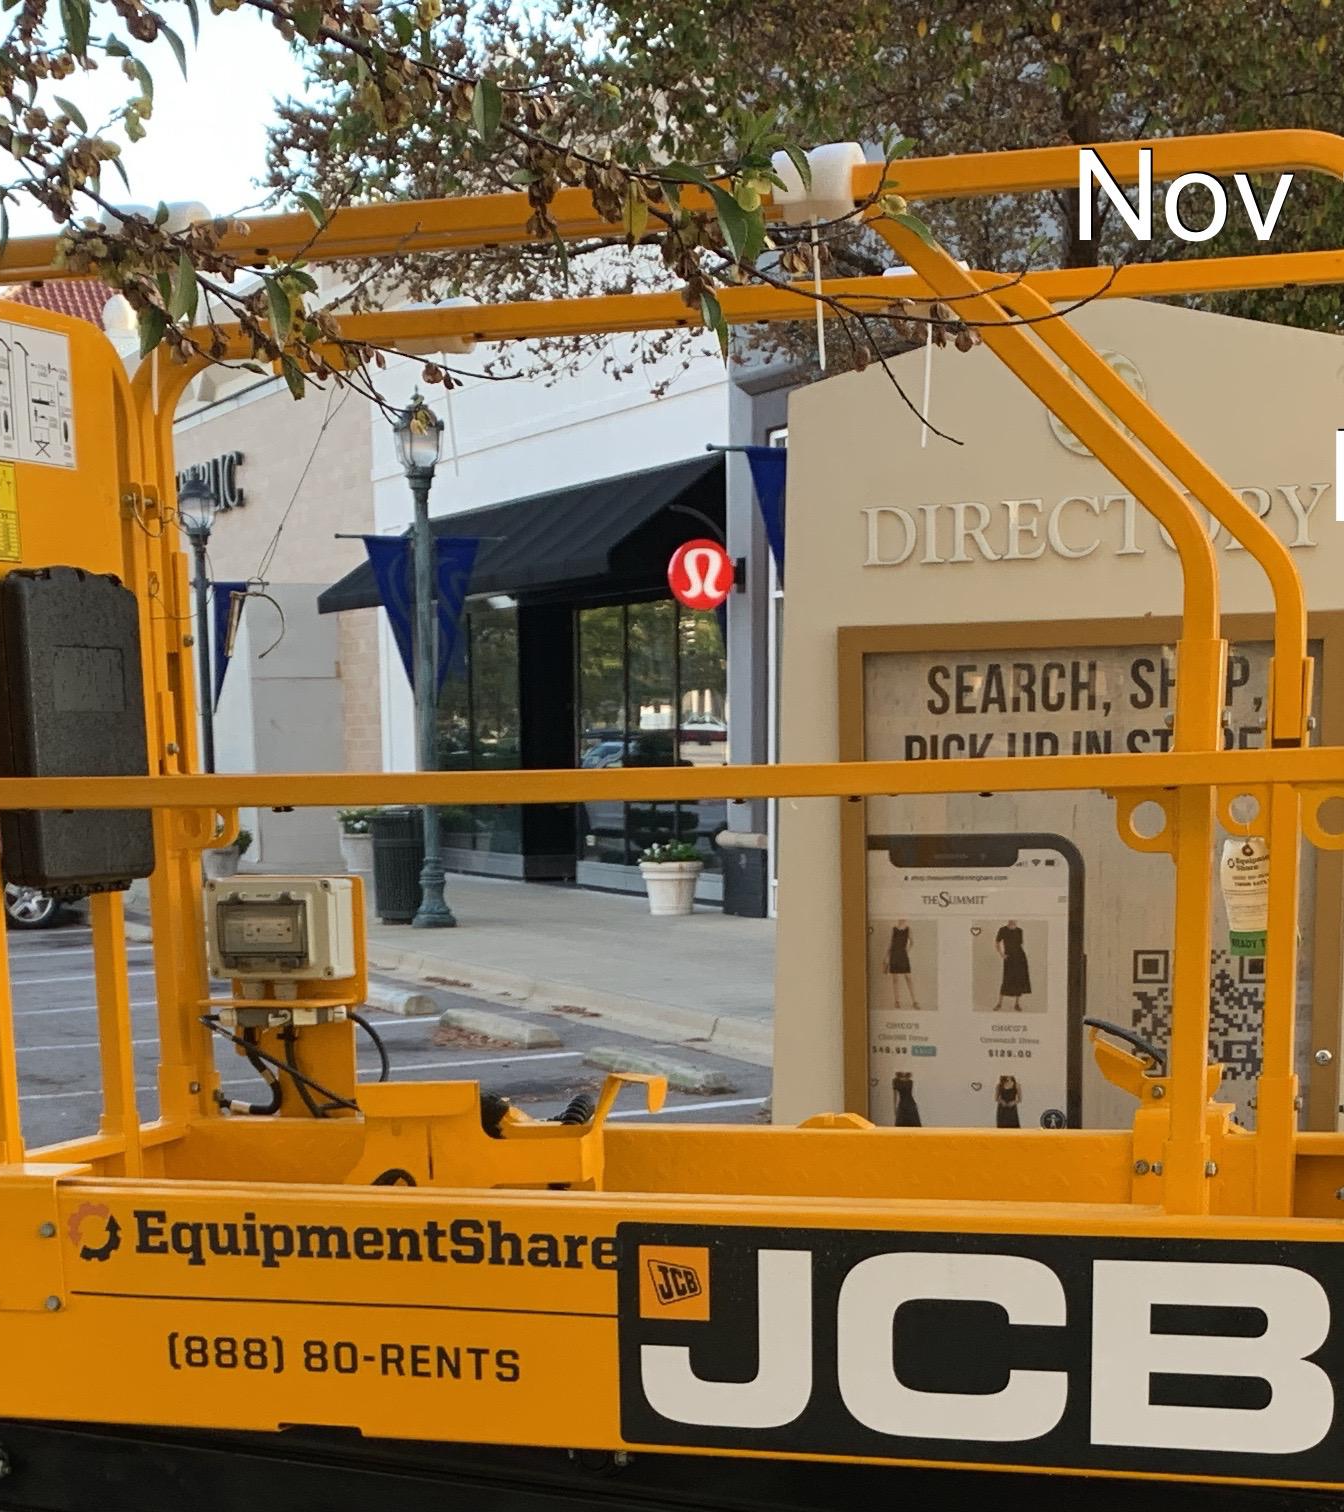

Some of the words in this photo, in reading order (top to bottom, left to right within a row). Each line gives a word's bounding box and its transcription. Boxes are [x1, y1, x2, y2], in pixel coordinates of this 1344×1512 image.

[927, 660, 1113, 717] SEARCH,
[1129, 656, 1264, 713] SHP,
[133, 1208, 620, 1270] EquipmentShare
[656, 1264, 698, 1300] JCB
[168, 1331, 284, 1374] (888)
[303, 1339, 521, 1383] 80-RENTS
[640, 1247, 1337, 1455] JCB
